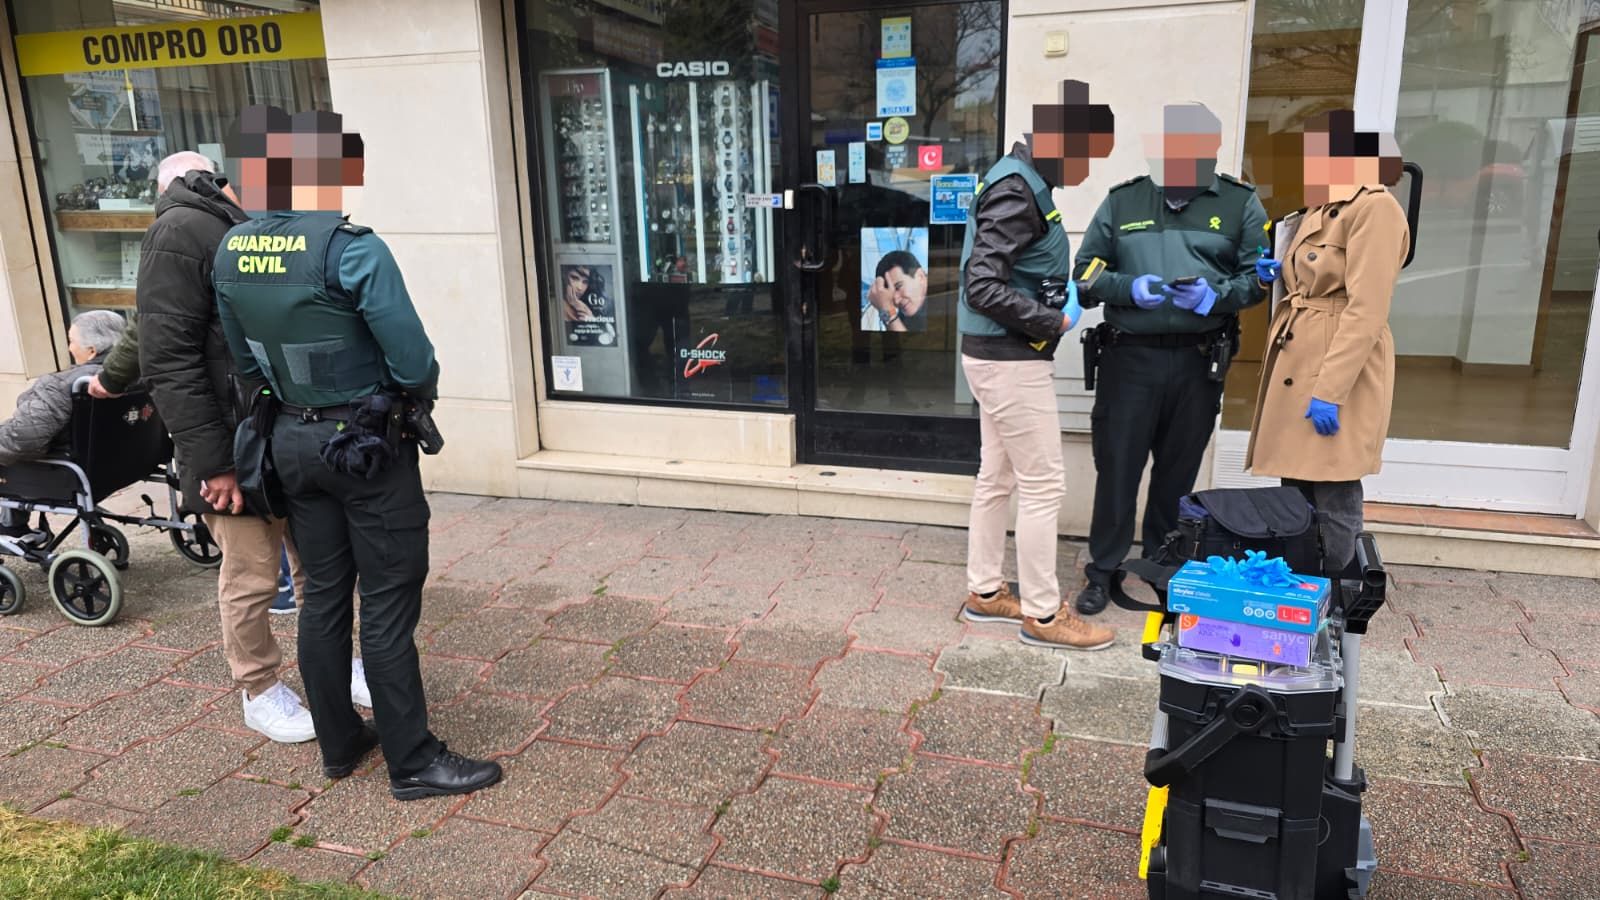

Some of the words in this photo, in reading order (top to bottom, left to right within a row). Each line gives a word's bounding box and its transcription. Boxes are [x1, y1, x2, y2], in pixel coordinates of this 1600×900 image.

[83, 27, 206, 65] COMPRO
[218, 21, 282, 56] ORO
[656, 61, 730, 77] CASIO
[227, 235, 306, 252] GUARDIA
[238, 255, 286, 273] CIVIL
[588, 293, 605, 306] Go
[1183, 616, 1192, 627] S
[1262, 630, 1305, 645] sanyc
